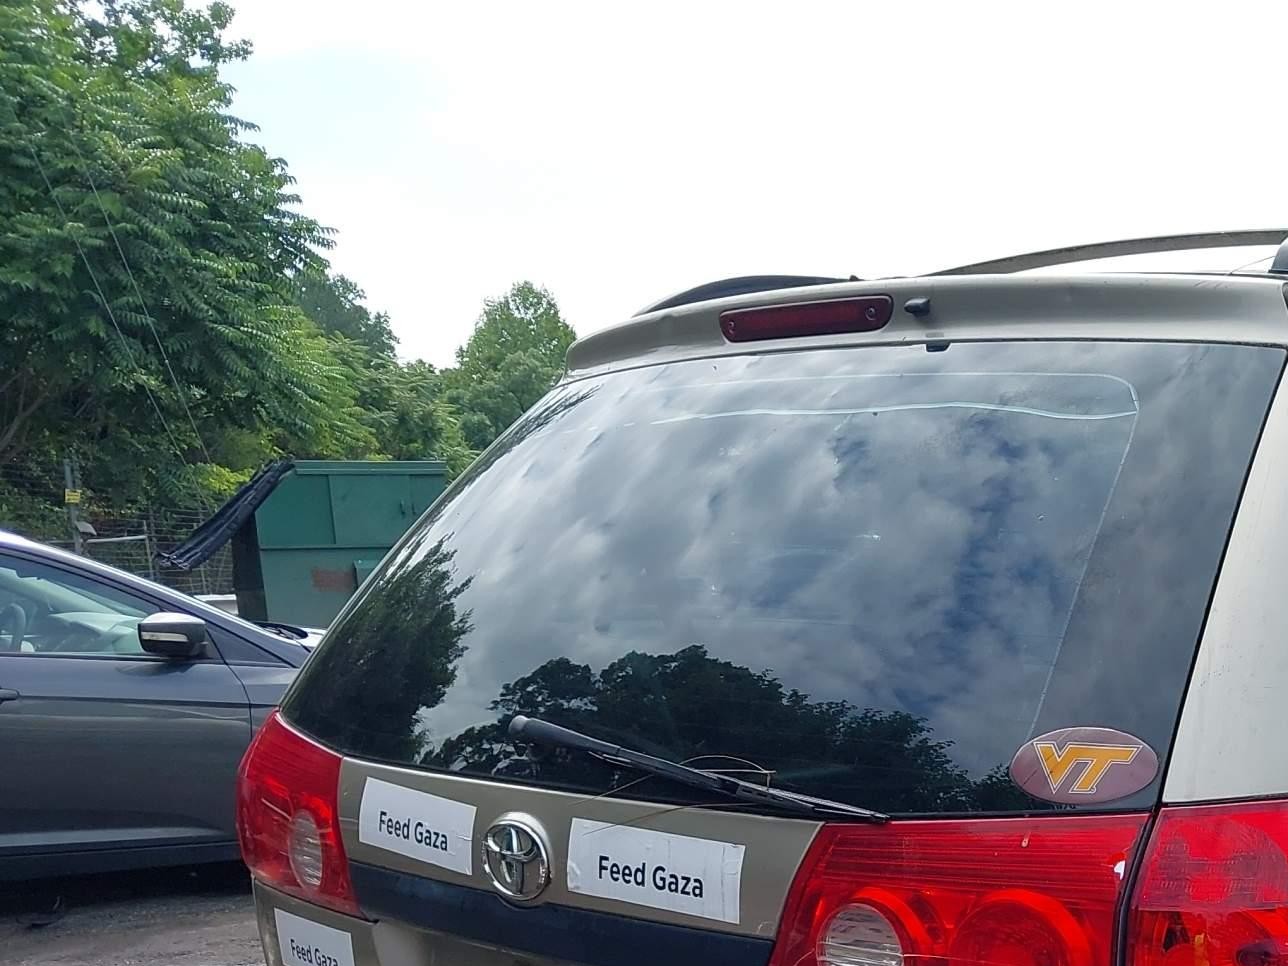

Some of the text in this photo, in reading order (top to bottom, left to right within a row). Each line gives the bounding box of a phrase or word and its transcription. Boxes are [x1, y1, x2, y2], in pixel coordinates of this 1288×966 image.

[1033, 741, 1144, 794] VT
[378, 811, 448, 852] Feed Gaza
[598, 856, 704, 899] Feed Gaza
[290, 939, 313, 965] Feed
